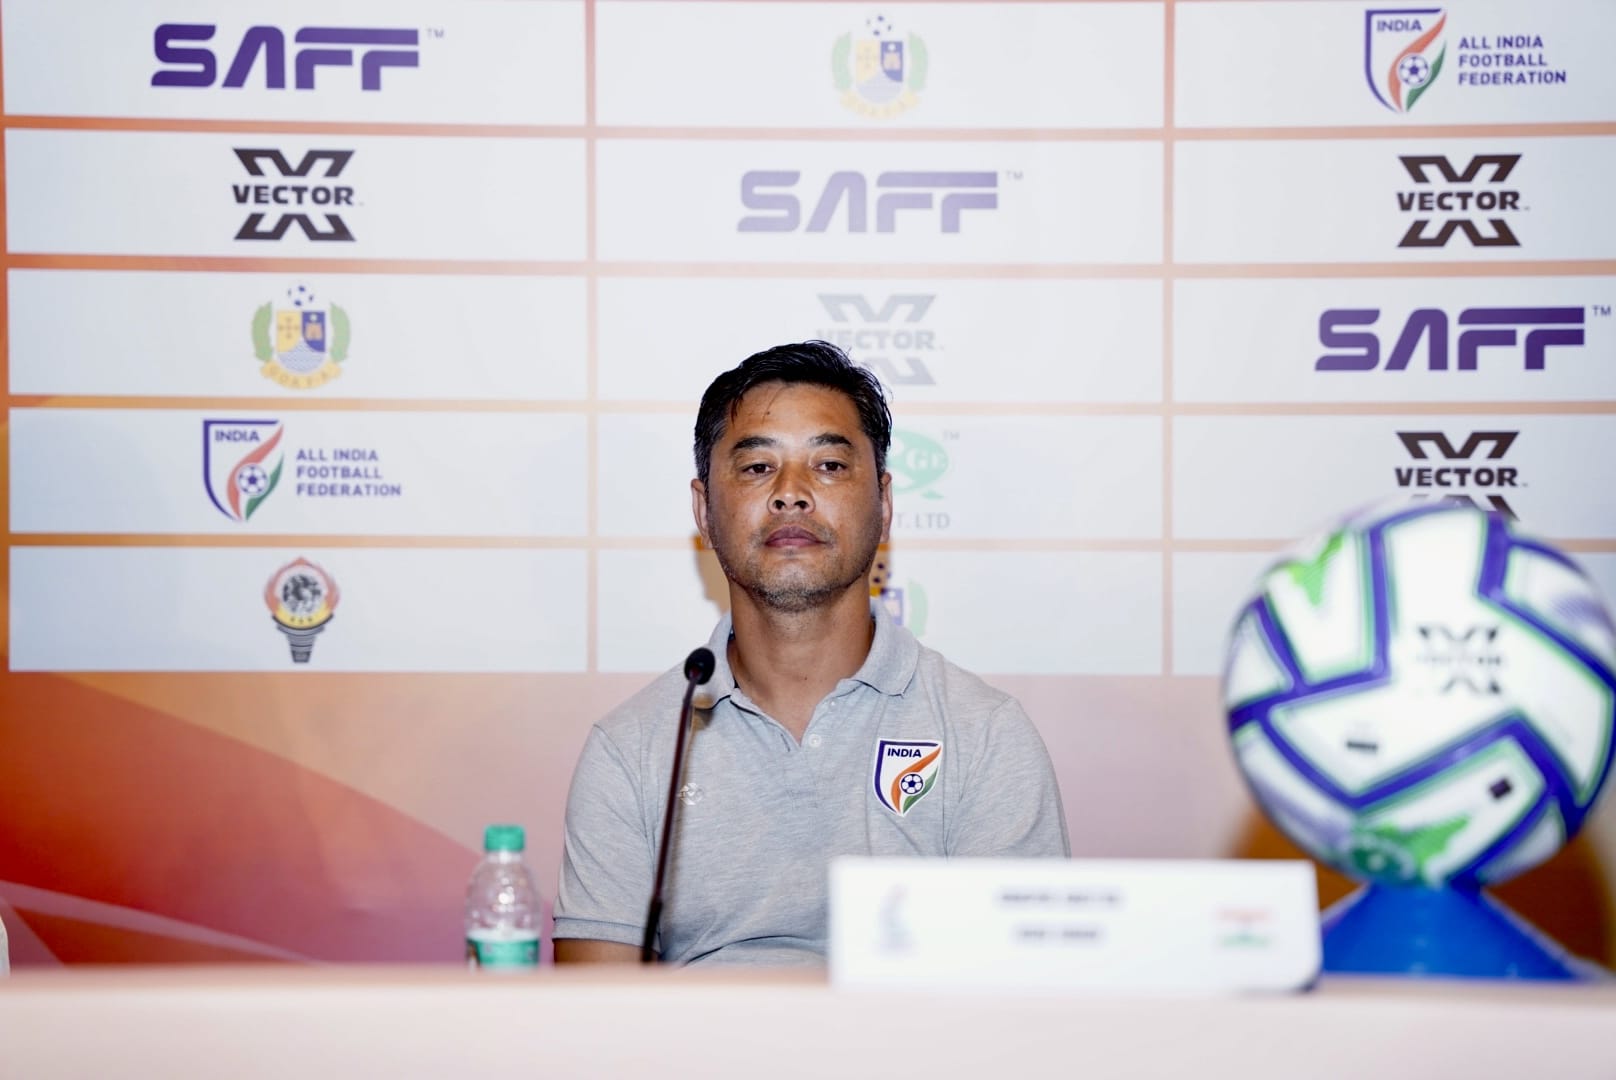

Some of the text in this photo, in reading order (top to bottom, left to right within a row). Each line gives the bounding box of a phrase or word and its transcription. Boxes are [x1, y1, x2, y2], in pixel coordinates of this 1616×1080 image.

[1376, 19, 1423, 33] INDIA
[1458, 35, 1544, 50] ALL INDIA
[151, 23, 445, 91] SAFF TM
[1458, 53, 1548, 68] FOOTBALL
[1458, 71, 1567, 86] FEDERATION
[231, 184, 354, 206] VECTOR
[736, 170, 999, 234] SAFF
[1396, 190, 1521, 211] VECTOR
[816, 328, 935, 351] VECTOR
[1315, 305, 1612, 371] SAFF TM
[215, 429, 260, 443] INDIA
[296, 448, 379, 462] ALL INDIA
[296, 465, 383, 480] FOOTBALL
[1394, 467, 1518, 487] VECTOR
[296, 483, 401, 498] FEDERATION
[887, 748, 922, 758] INDIA
